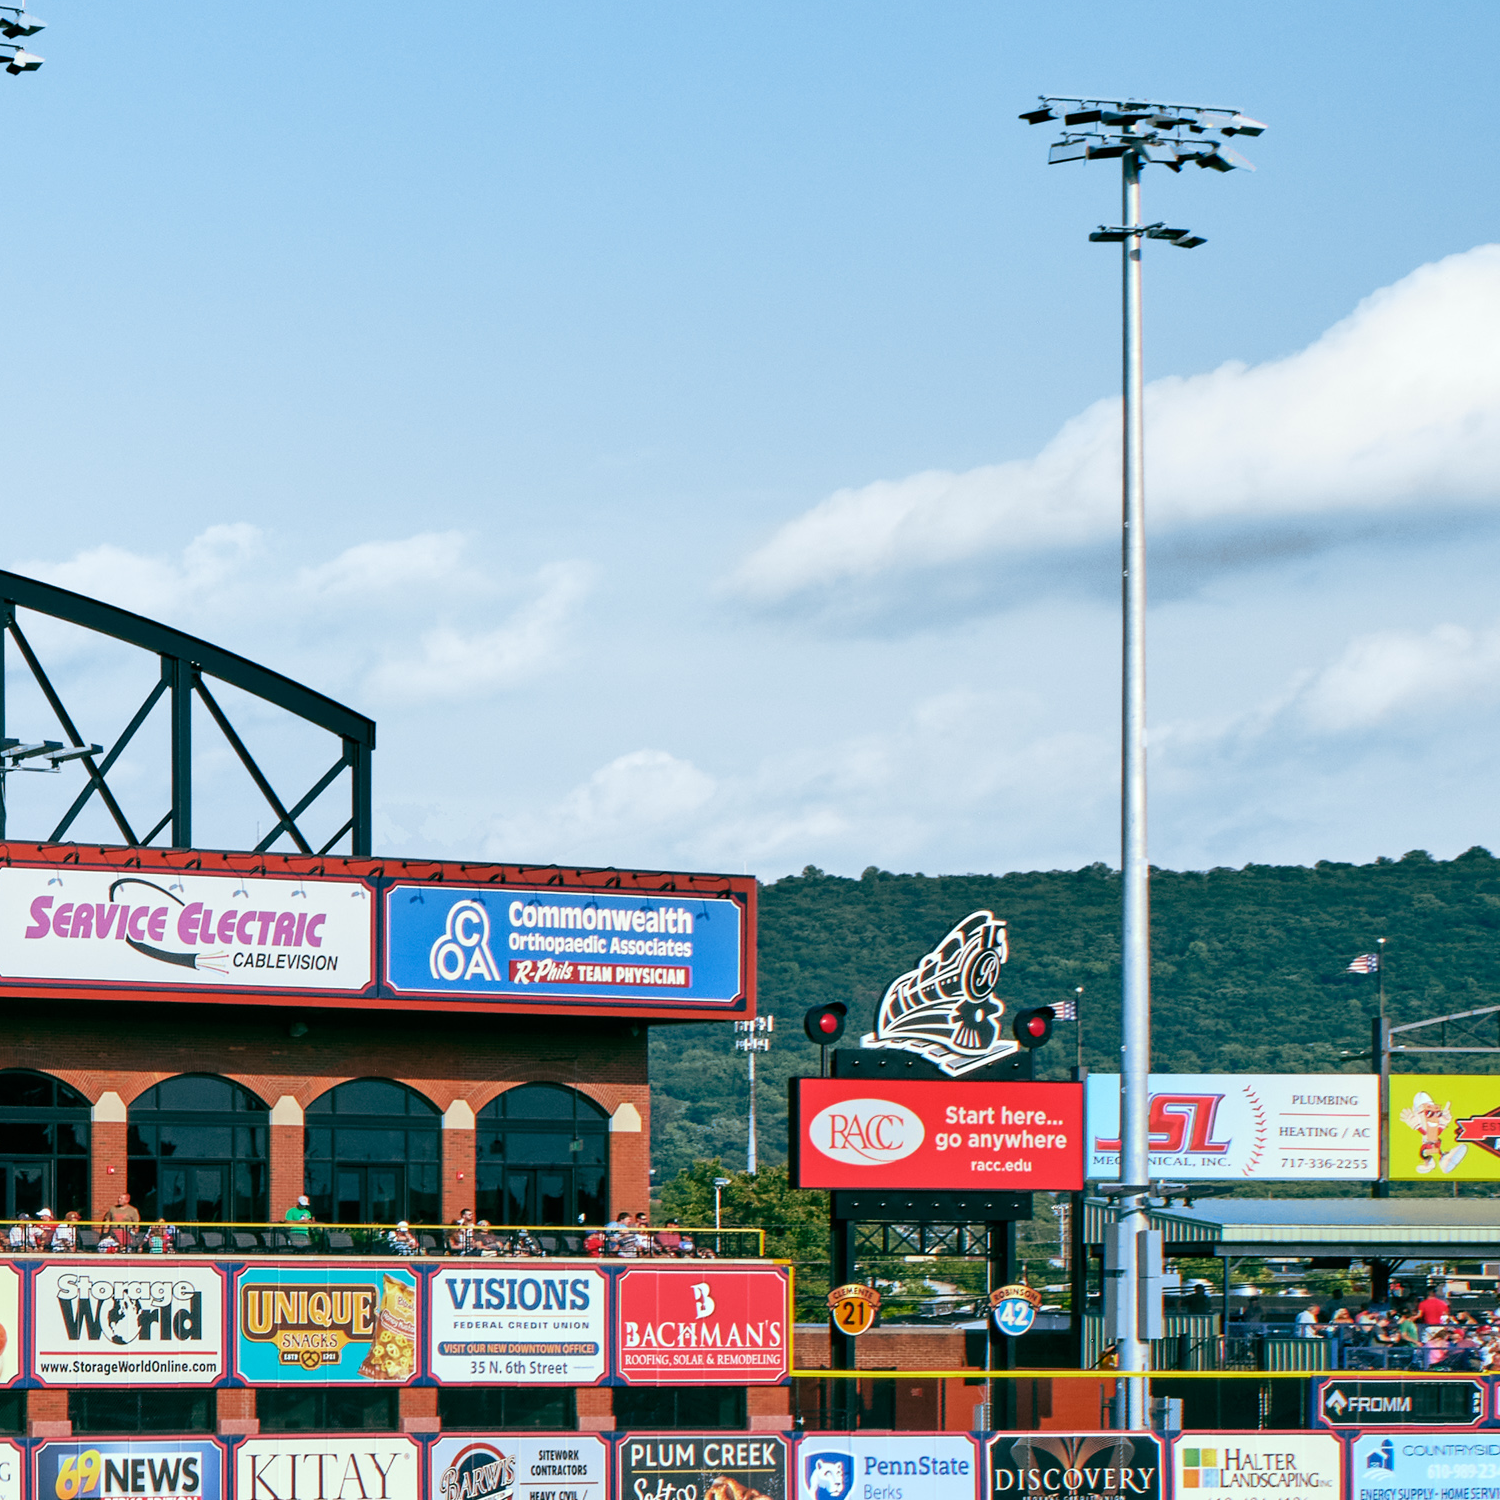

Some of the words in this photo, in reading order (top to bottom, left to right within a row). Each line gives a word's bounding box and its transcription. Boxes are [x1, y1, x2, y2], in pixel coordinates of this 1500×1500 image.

[25, 896, 167, 941] SERVICE
[177, 902, 326, 948] ELECTRIC
[509, 901, 692, 934] Commonwealth
[509, 933, 606, 954] Orthopaedic
[610, 936, 691, 957] Associates
[232, 952, 338, 970] CABLEVISION
[514, 958, 574, 985] R-Phils
[578, 965, 612, 982] TEAM
[616, 967, 685, 985] PHYSICIAN
[1292, 1095, 1357, 1105] PLUMBING
[945, 1105, 995, 1125] Start
[1001, 1105, 1063, 1126] here...
[828, 1112, 907, 1163] RACC
[936, 1133, 955, 1151] go
[961, 1130, 1067, 1151] anywhere
[1279, 1127, 1338, 1137] HEATING
[970, 1160, 1032, 1174] racc.edu
[1281, 1158, 1368, 1168] 717-336-2255
[55, 1274, 195, 1308] Storage
[446, 1278, 590, 1311] VISIONS
[833, 1288, 873, 1300] CLEMENTE
[994, 1288, 1038, 1300] ROBINSON
[60, 1292, 202, 1345] World
[248, 1291, 374, 1334] UNIQUE
[843, 1302, 865, 1325] 21
[1000, 1302, 1029, 1326] 42
[453, 1321, 503, 1329] FEDERAL
[508, 1321, 549, 1329] CREDIT
[553, 1321, 590, 1329] UNION
[626, 1321, 781, 1348] BACHMAN'S
[283, 1333, 338, 1348] SNACKS
[507, 1343, 560, 1354] DOWNTOWN
[40, 1359, 216, 1375] www.StorageWorldOnline.com
[470, 1361, 483, 1374] 35
[507, 1360, 524, 1374] 6th
[529, 1360, 568, 1375] Street
[625, 1354, 669, 1367] ROOFING,
[717, 1353, 781, 1366] REMODELING
[1348, 1397, 1412, 1412] FROMM
[538, 1450, 580, 1461] SITEWORK
[631, 1443, 697, 1466] PLUM
[703, 1443, 776, 1465] CREEK
[1224, 1448, 1295, 1472] HALTER
[55, 1449, 101, 1500] 69
[104, 1457, 200, 1492] NEWS
[530, 1464, 587, 1476] CONTRACTORS
[864, 1456, 968, 1475] PennState
[995, 1467, 1155, 1492] DISCOVERY
[1218, 1469, 1319, 1489] LANDSCAPING
[863, 1485, 903, 1500] Berks
